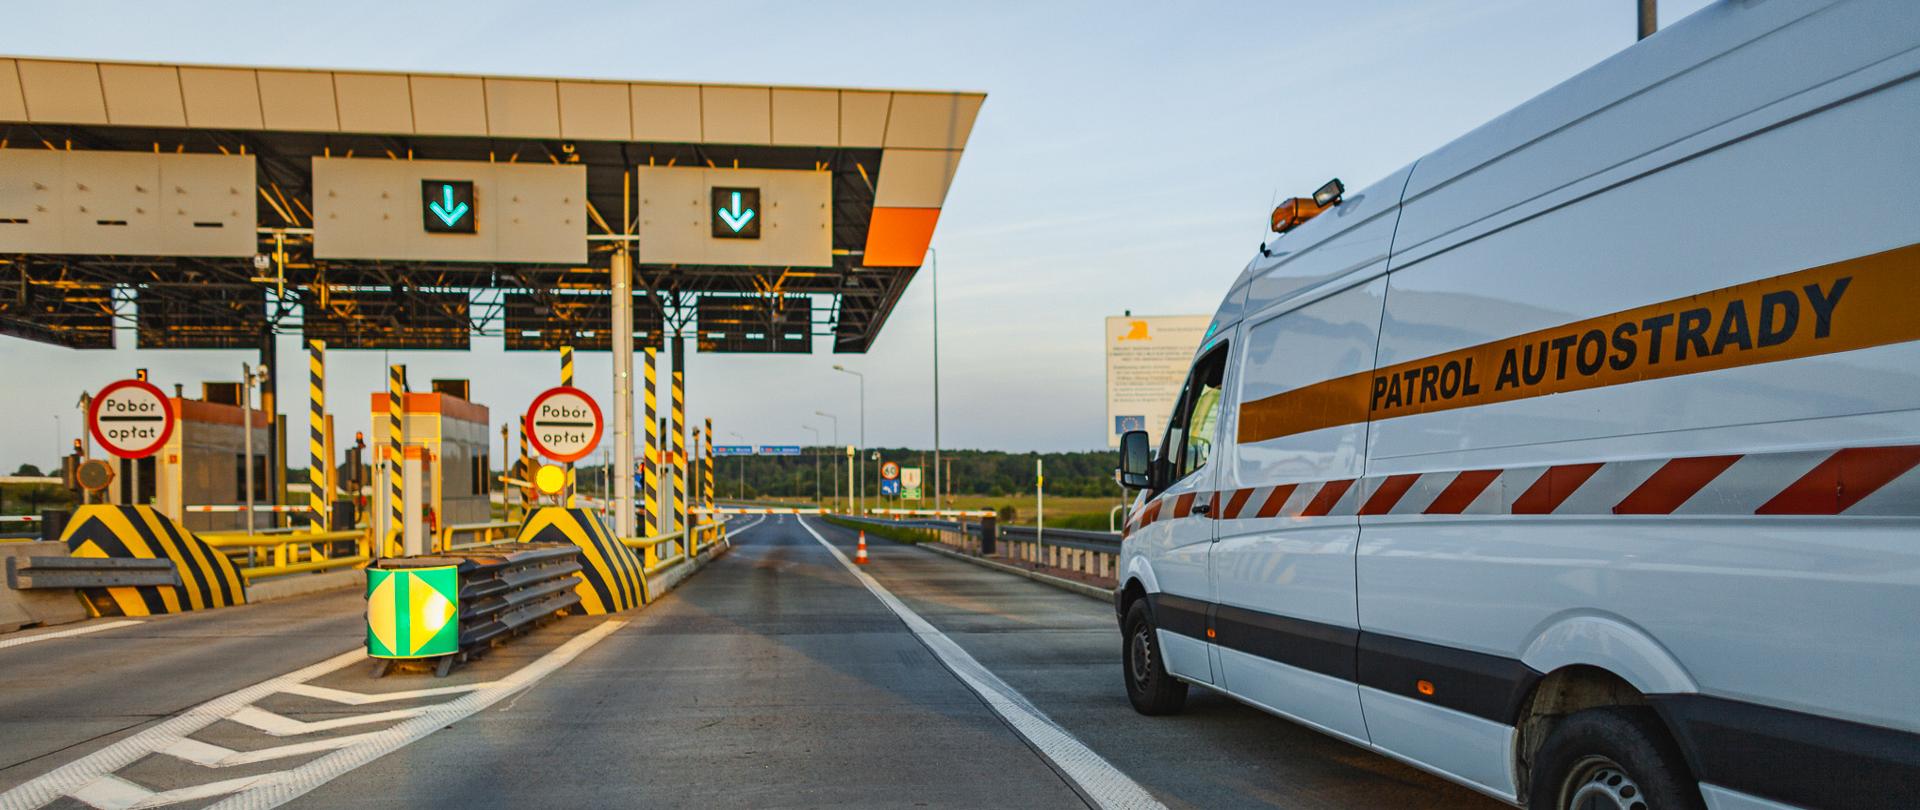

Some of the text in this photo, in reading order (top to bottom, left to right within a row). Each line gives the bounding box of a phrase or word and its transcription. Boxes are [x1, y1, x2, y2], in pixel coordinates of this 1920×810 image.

[1371, 276, 1853, 412] PATROL AUTOSTRADY
[106, 398, 156, 412] Pobór
[542, 404, 588, 418] Pobór
[108, 425, 155, 442] opłat
[543, 431, 586, 446] opłat
